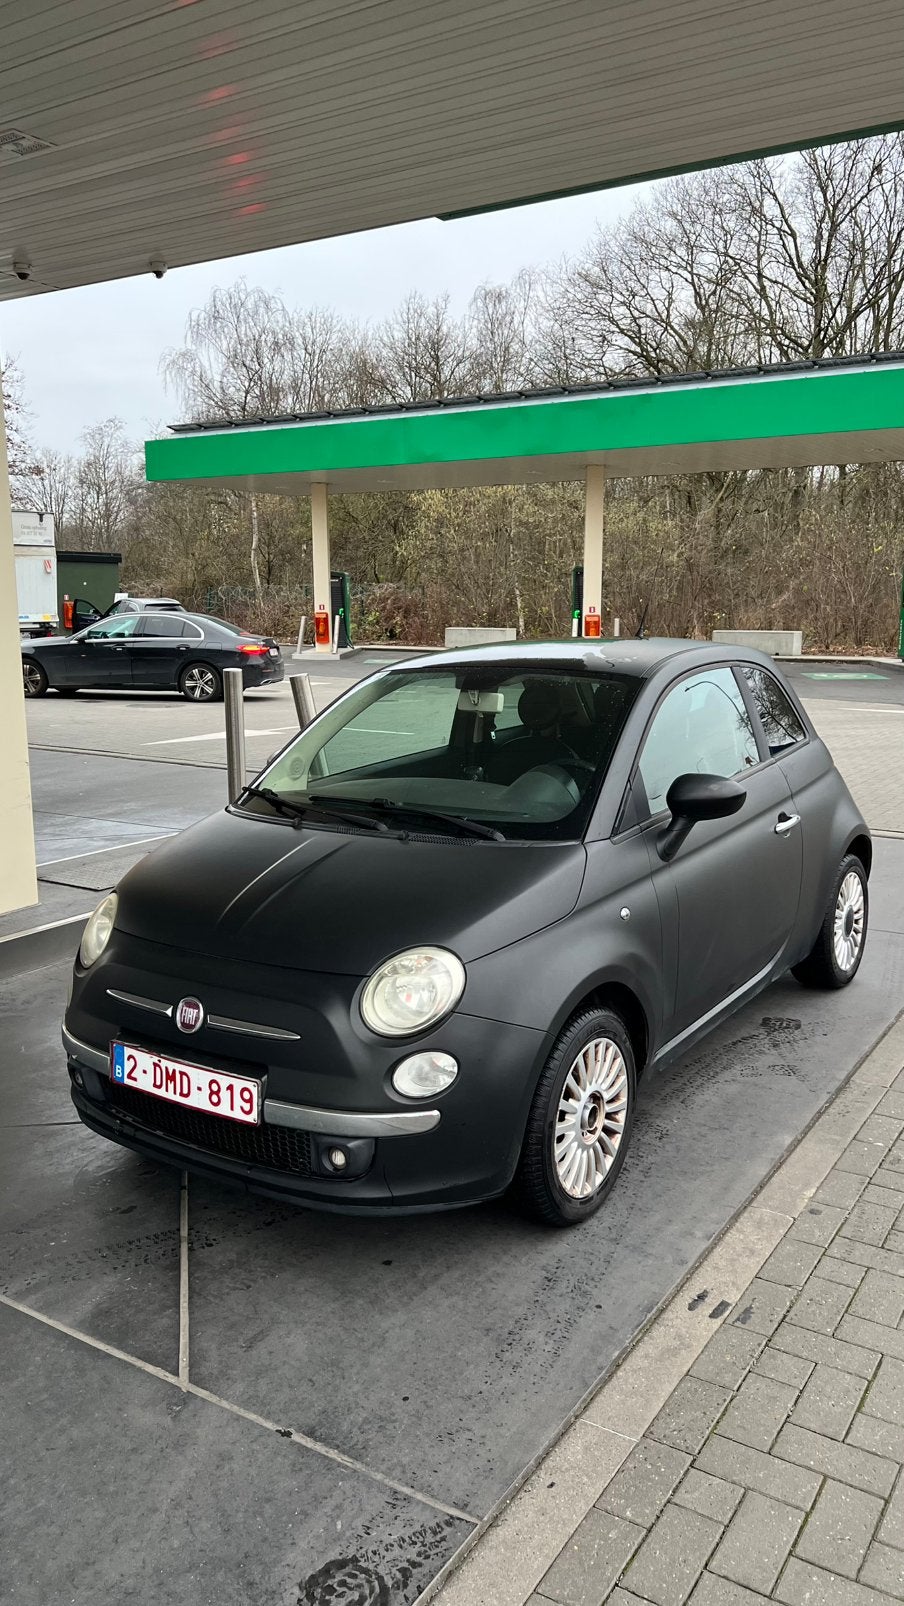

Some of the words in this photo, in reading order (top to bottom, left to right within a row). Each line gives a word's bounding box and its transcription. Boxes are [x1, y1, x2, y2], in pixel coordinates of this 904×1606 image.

[181, 1006, 198, 1025] FIAT
[115, 1065, 122, 1078] B
[126, 1054, 254, 1115] 2-DMD-819
